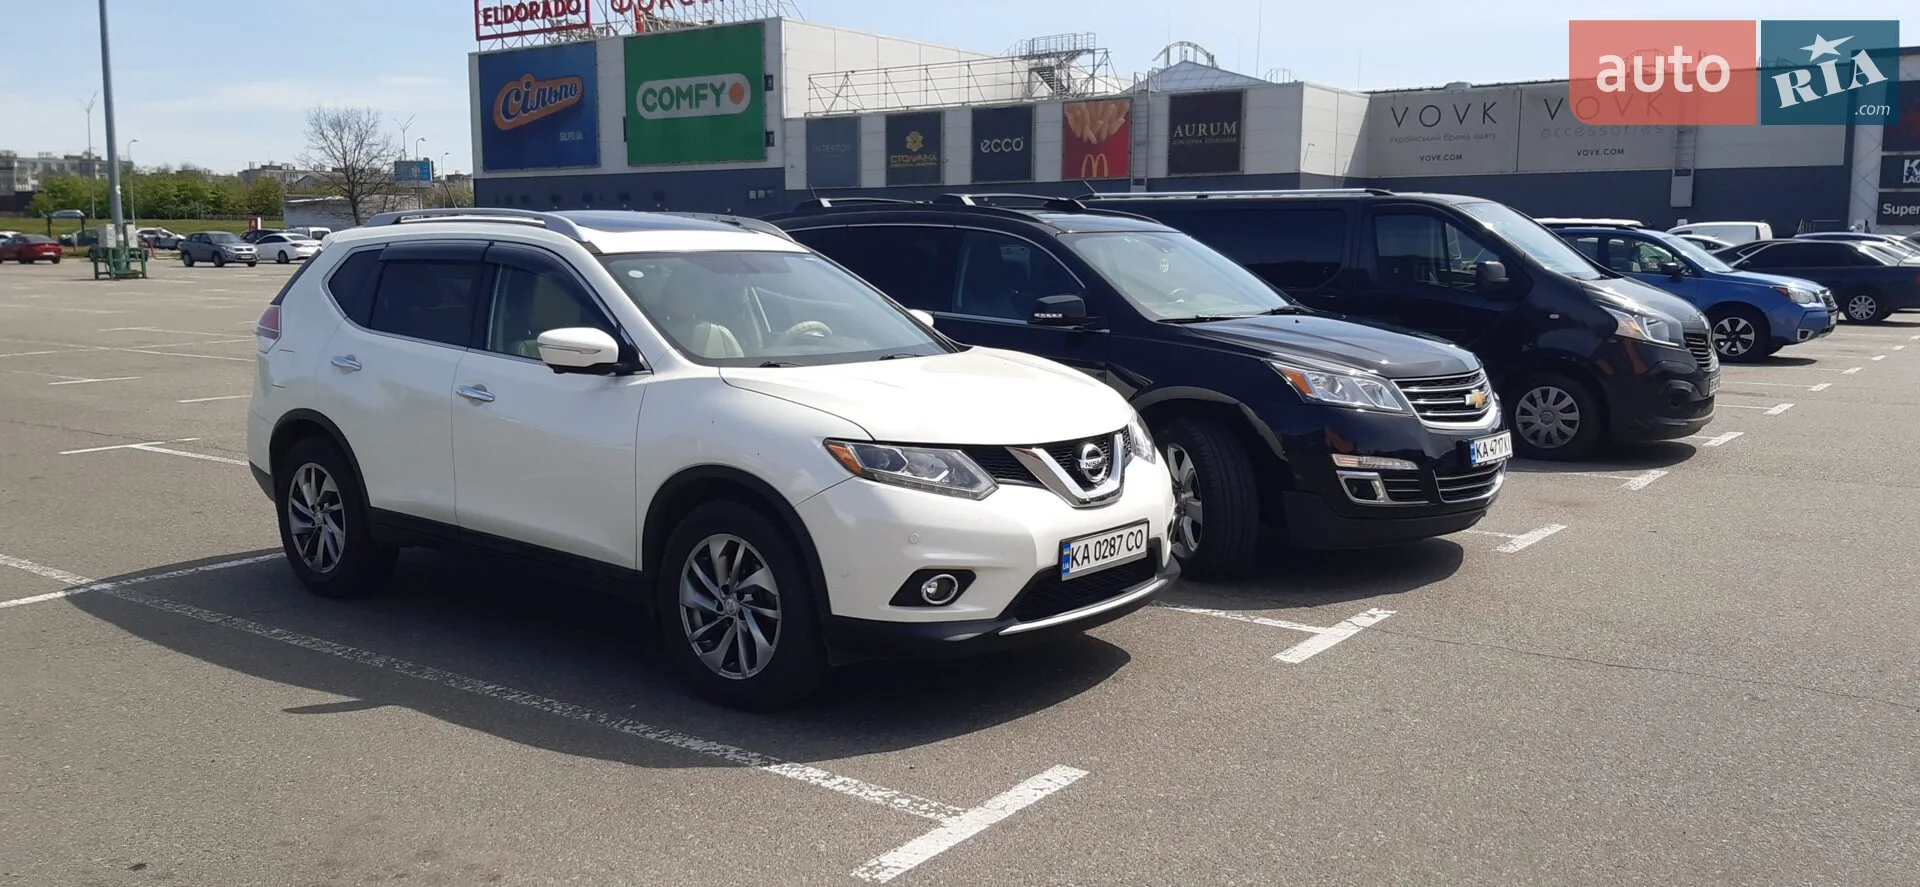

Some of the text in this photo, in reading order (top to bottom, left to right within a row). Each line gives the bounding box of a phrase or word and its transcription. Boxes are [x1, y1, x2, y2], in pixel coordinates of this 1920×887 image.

[483, 0, 581, 26] ELDORADO
[501, 80, 579, 122] Сільпо
[641, 81, 727, 113] COMFY
[1391, 101, 1497, 128] VOVK
[1172, 121, 1238, 137] AURUM
[980, 137, 1024, 153] ecco
[1576, 148, 1625, 157] VOVK.COM
[1420, 153, 1463, 162] VOVK.COM
[1476, 441, 1488, 459] KA
[1085, 457, 1105, 468] NISS
[1071, 544, 1090, 568] KA
[1094, 534, 1124, 561] 0287
[1126, 529, 1144, 552] CO
